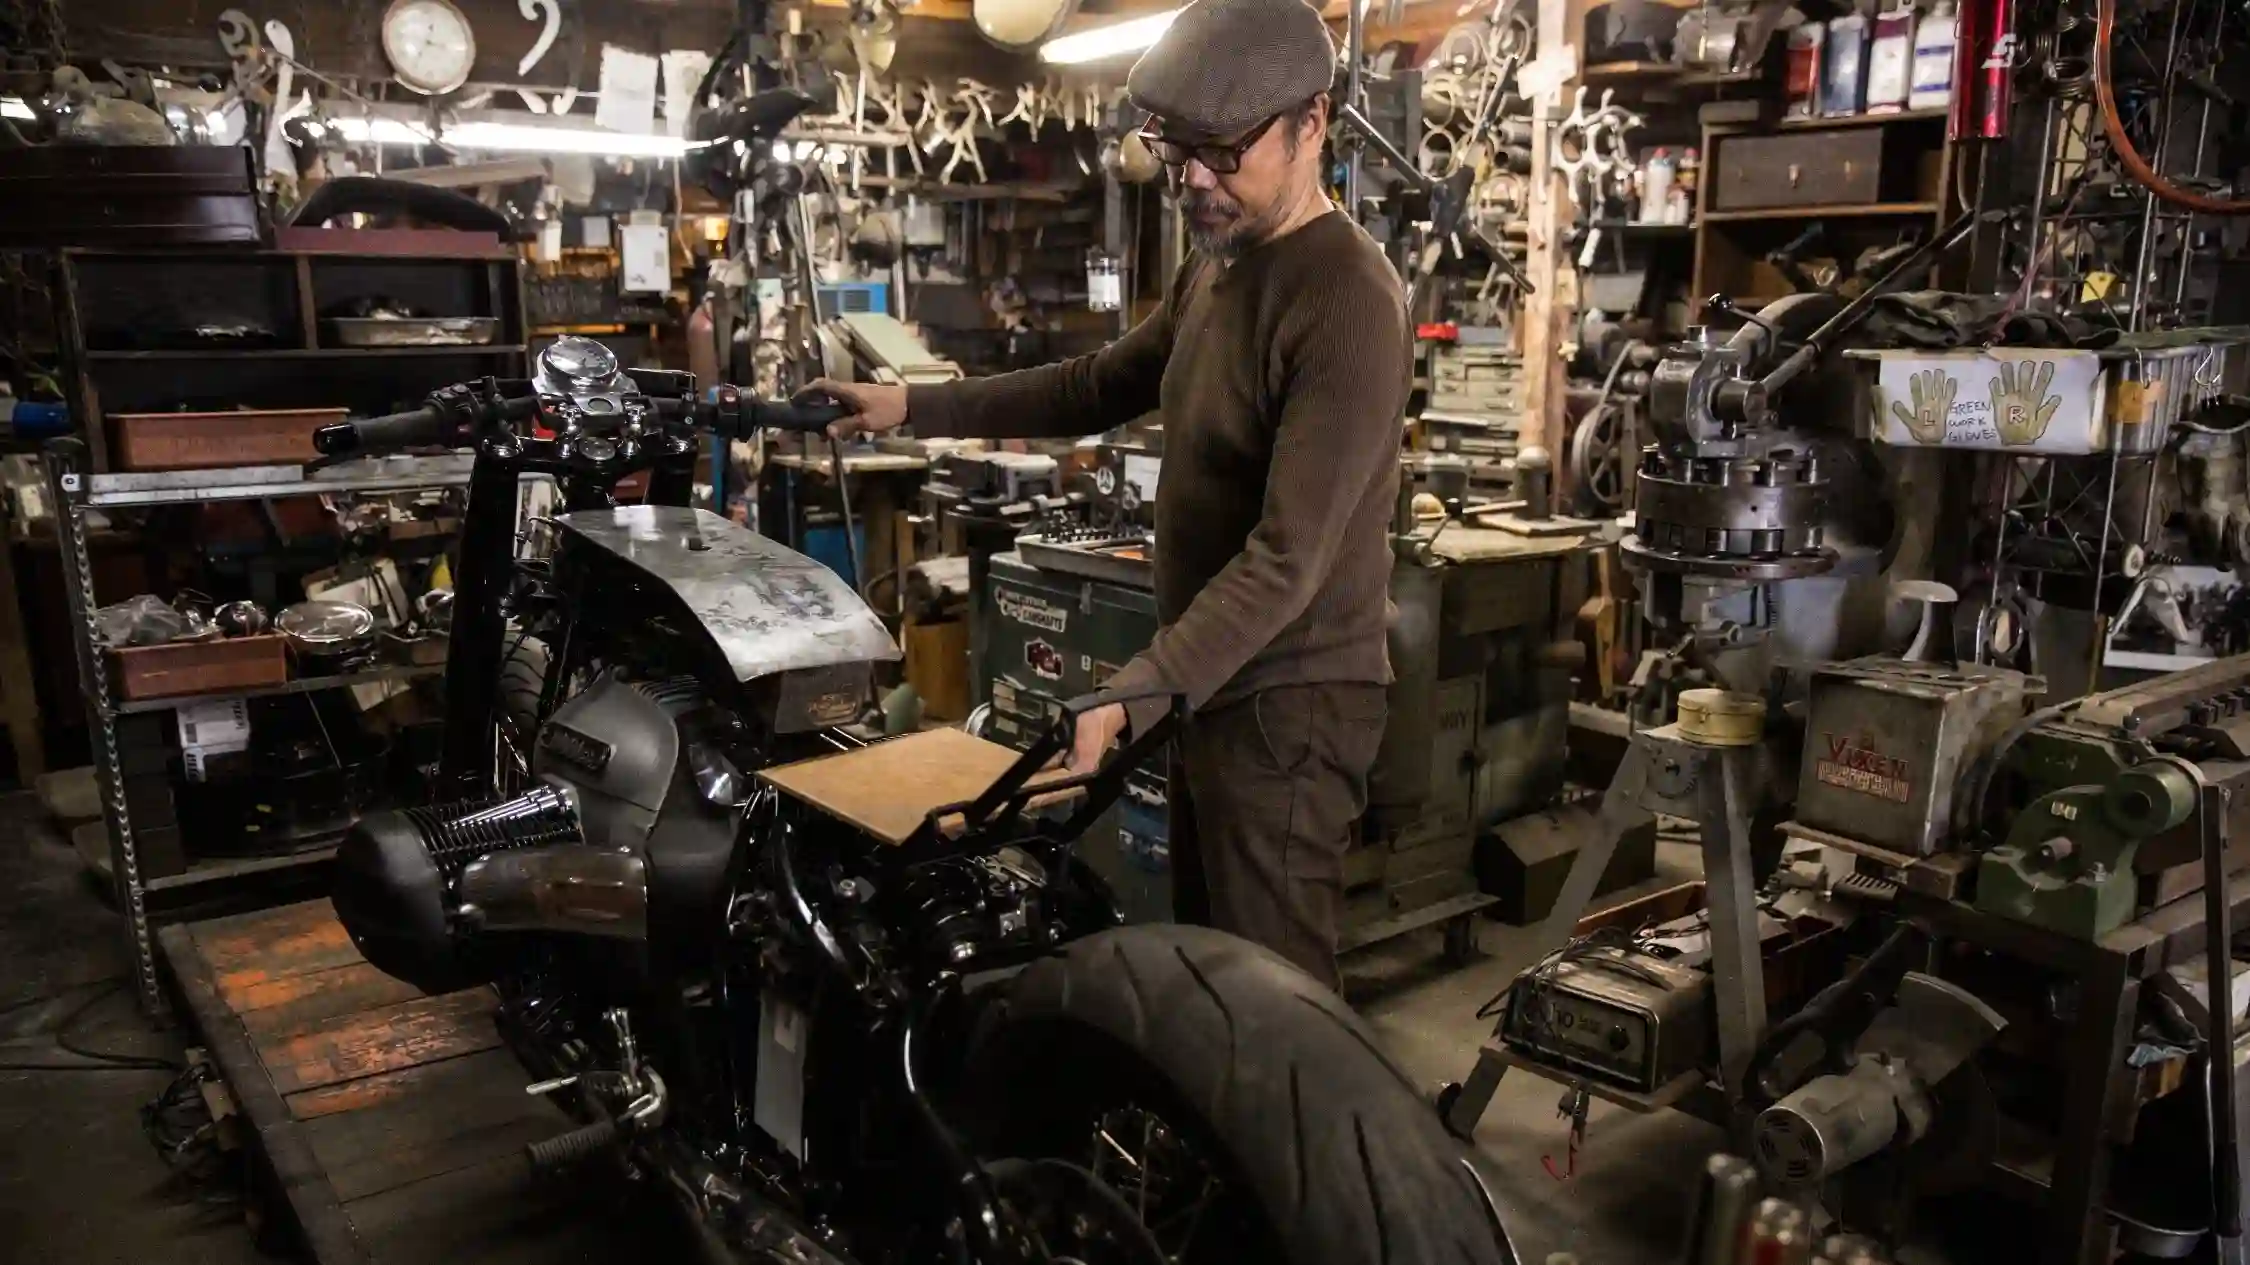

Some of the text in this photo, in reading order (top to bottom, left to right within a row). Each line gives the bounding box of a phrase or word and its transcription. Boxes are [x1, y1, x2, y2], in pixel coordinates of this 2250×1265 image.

[1950, 400, 1992, 415] GREEN
[2008, 405, 2027, 424] R
[1924, 411, 1936, 427] L
[1948, 416, 1987, 428] WORK
[1948, 428, 1998, 443] GLOVES
